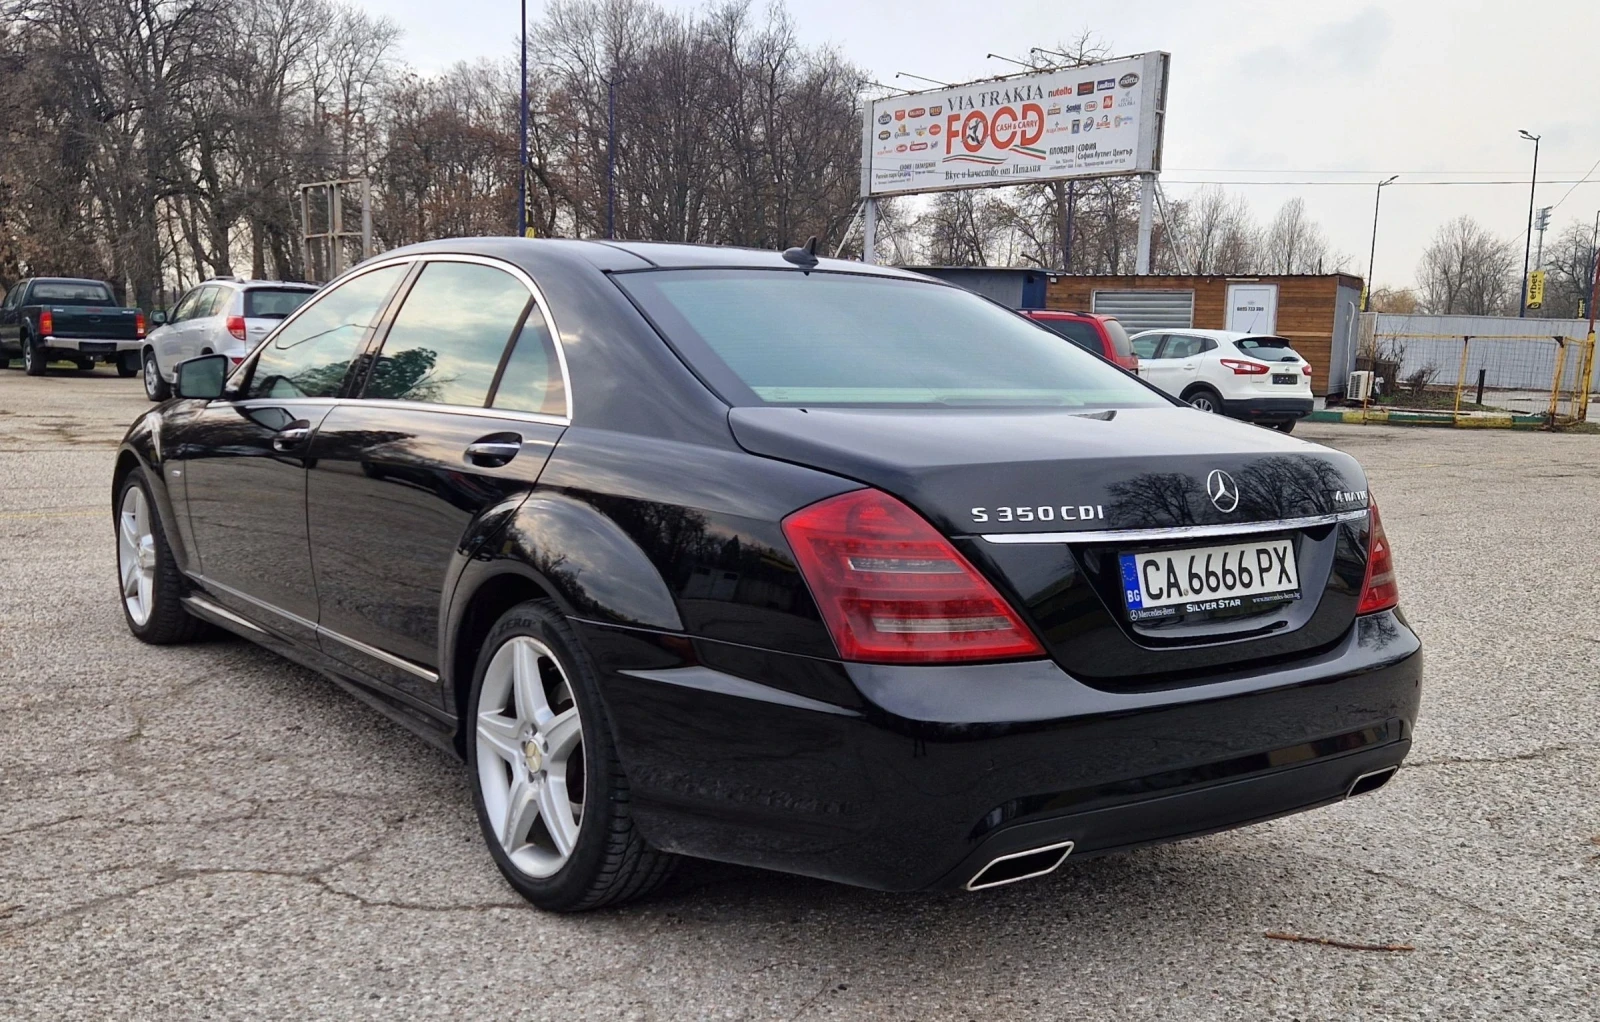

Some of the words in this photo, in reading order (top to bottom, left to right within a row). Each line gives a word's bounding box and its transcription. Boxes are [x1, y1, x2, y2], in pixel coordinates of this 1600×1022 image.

[948, 95, 975, 112] VIA
[979, 83, 1044, 108] TRAKIA
[1048, 86, 1073, 98] nutella
[945, 103, 1045, 155] FOOD
[996, 123, 1012, 132] CASH
[1018, 120, 1038, 129] CARRY
[1049, 145, 1075, 155] ПЛОВДИВ
[1078, 142, 1097, 152] СОФИЯ
[1077, 151, 1093, 160] София
[945, 170, 960, 181] Вкус
[967, 166, 998, 178] качество
[1012, 164, 1041, 175] Италия
[1530, 273, 1538, 300] efbet
[971, 507, 989, 522] S
[996, 506, 1055, 522] 350
[1060, 505, 1104, 521] CDI
[1127, 590, 1141, 602] BG
[1186, 602, 1221, 613] SILVER
[1218, 599, 1241, 609] STAR
[1138, 607, 1175, 619] Mercedes-Benz
